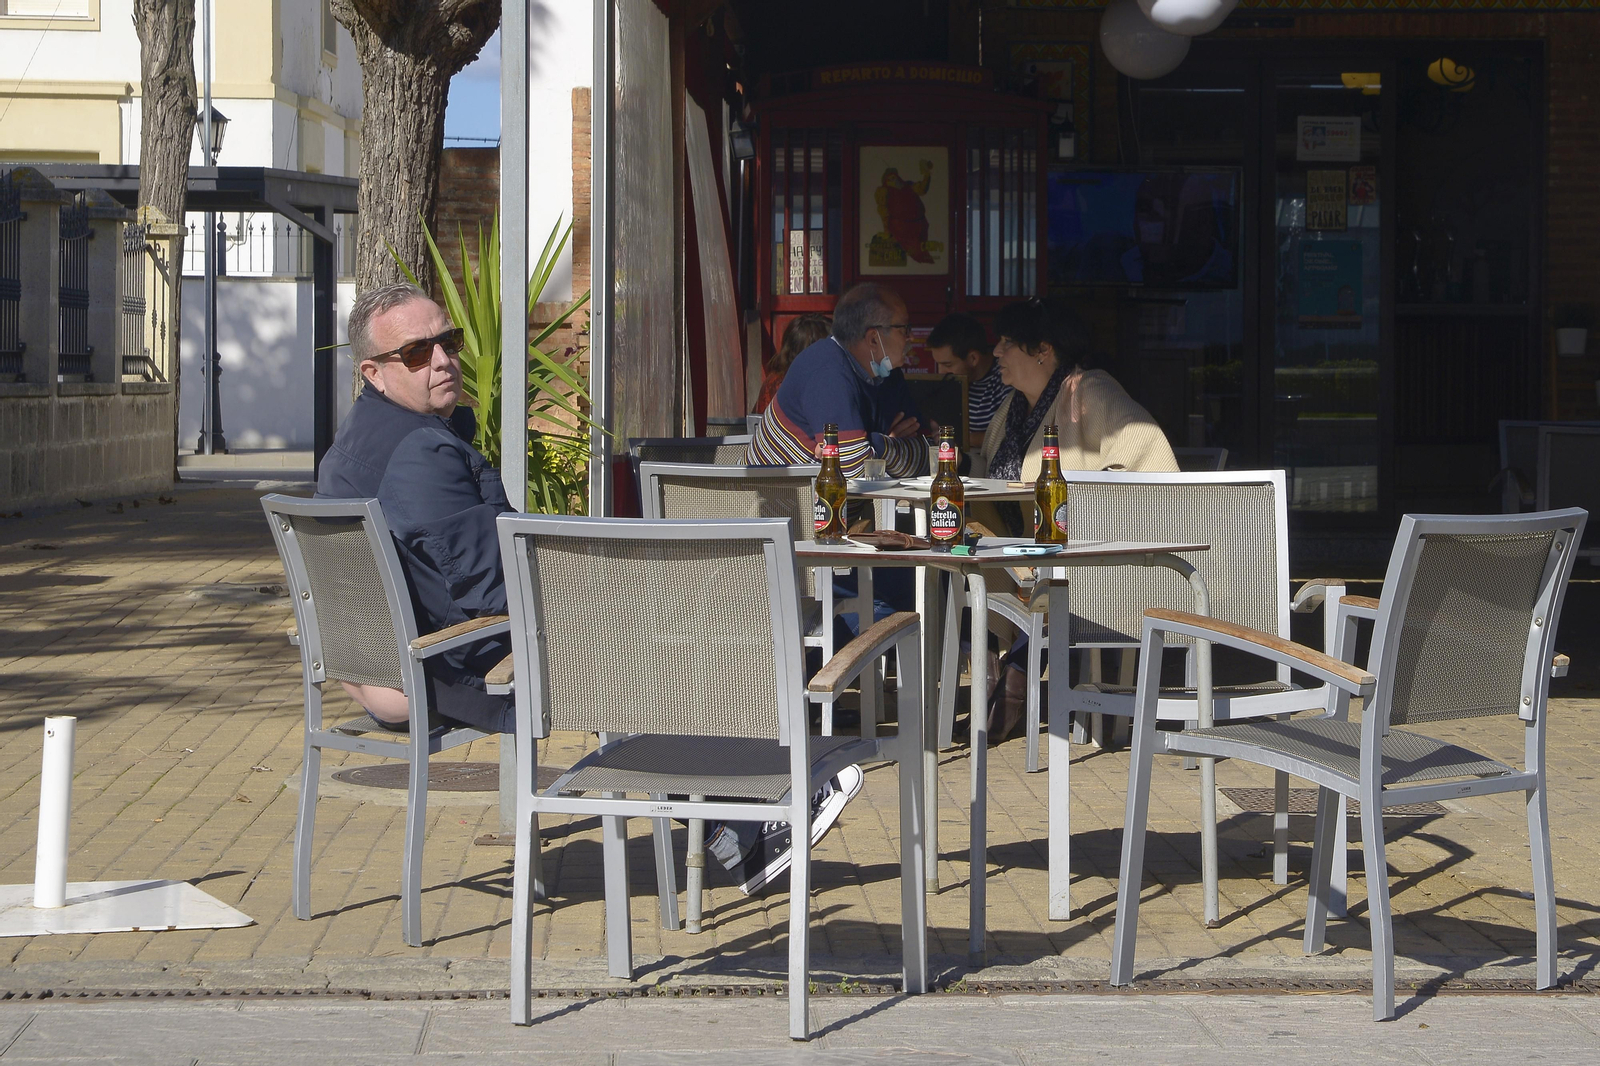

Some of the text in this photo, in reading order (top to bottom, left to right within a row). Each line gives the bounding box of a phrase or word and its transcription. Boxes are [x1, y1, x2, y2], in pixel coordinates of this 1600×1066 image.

[820, 65, 983, 84] REPARTO A DOMICILIO
[1311, 210, 1341, 227] PASAR
[790, 246, 822, 257] HAPY
[930, 510, 957, 519] Estrella
[931, 518, 956, 527] Galicia
